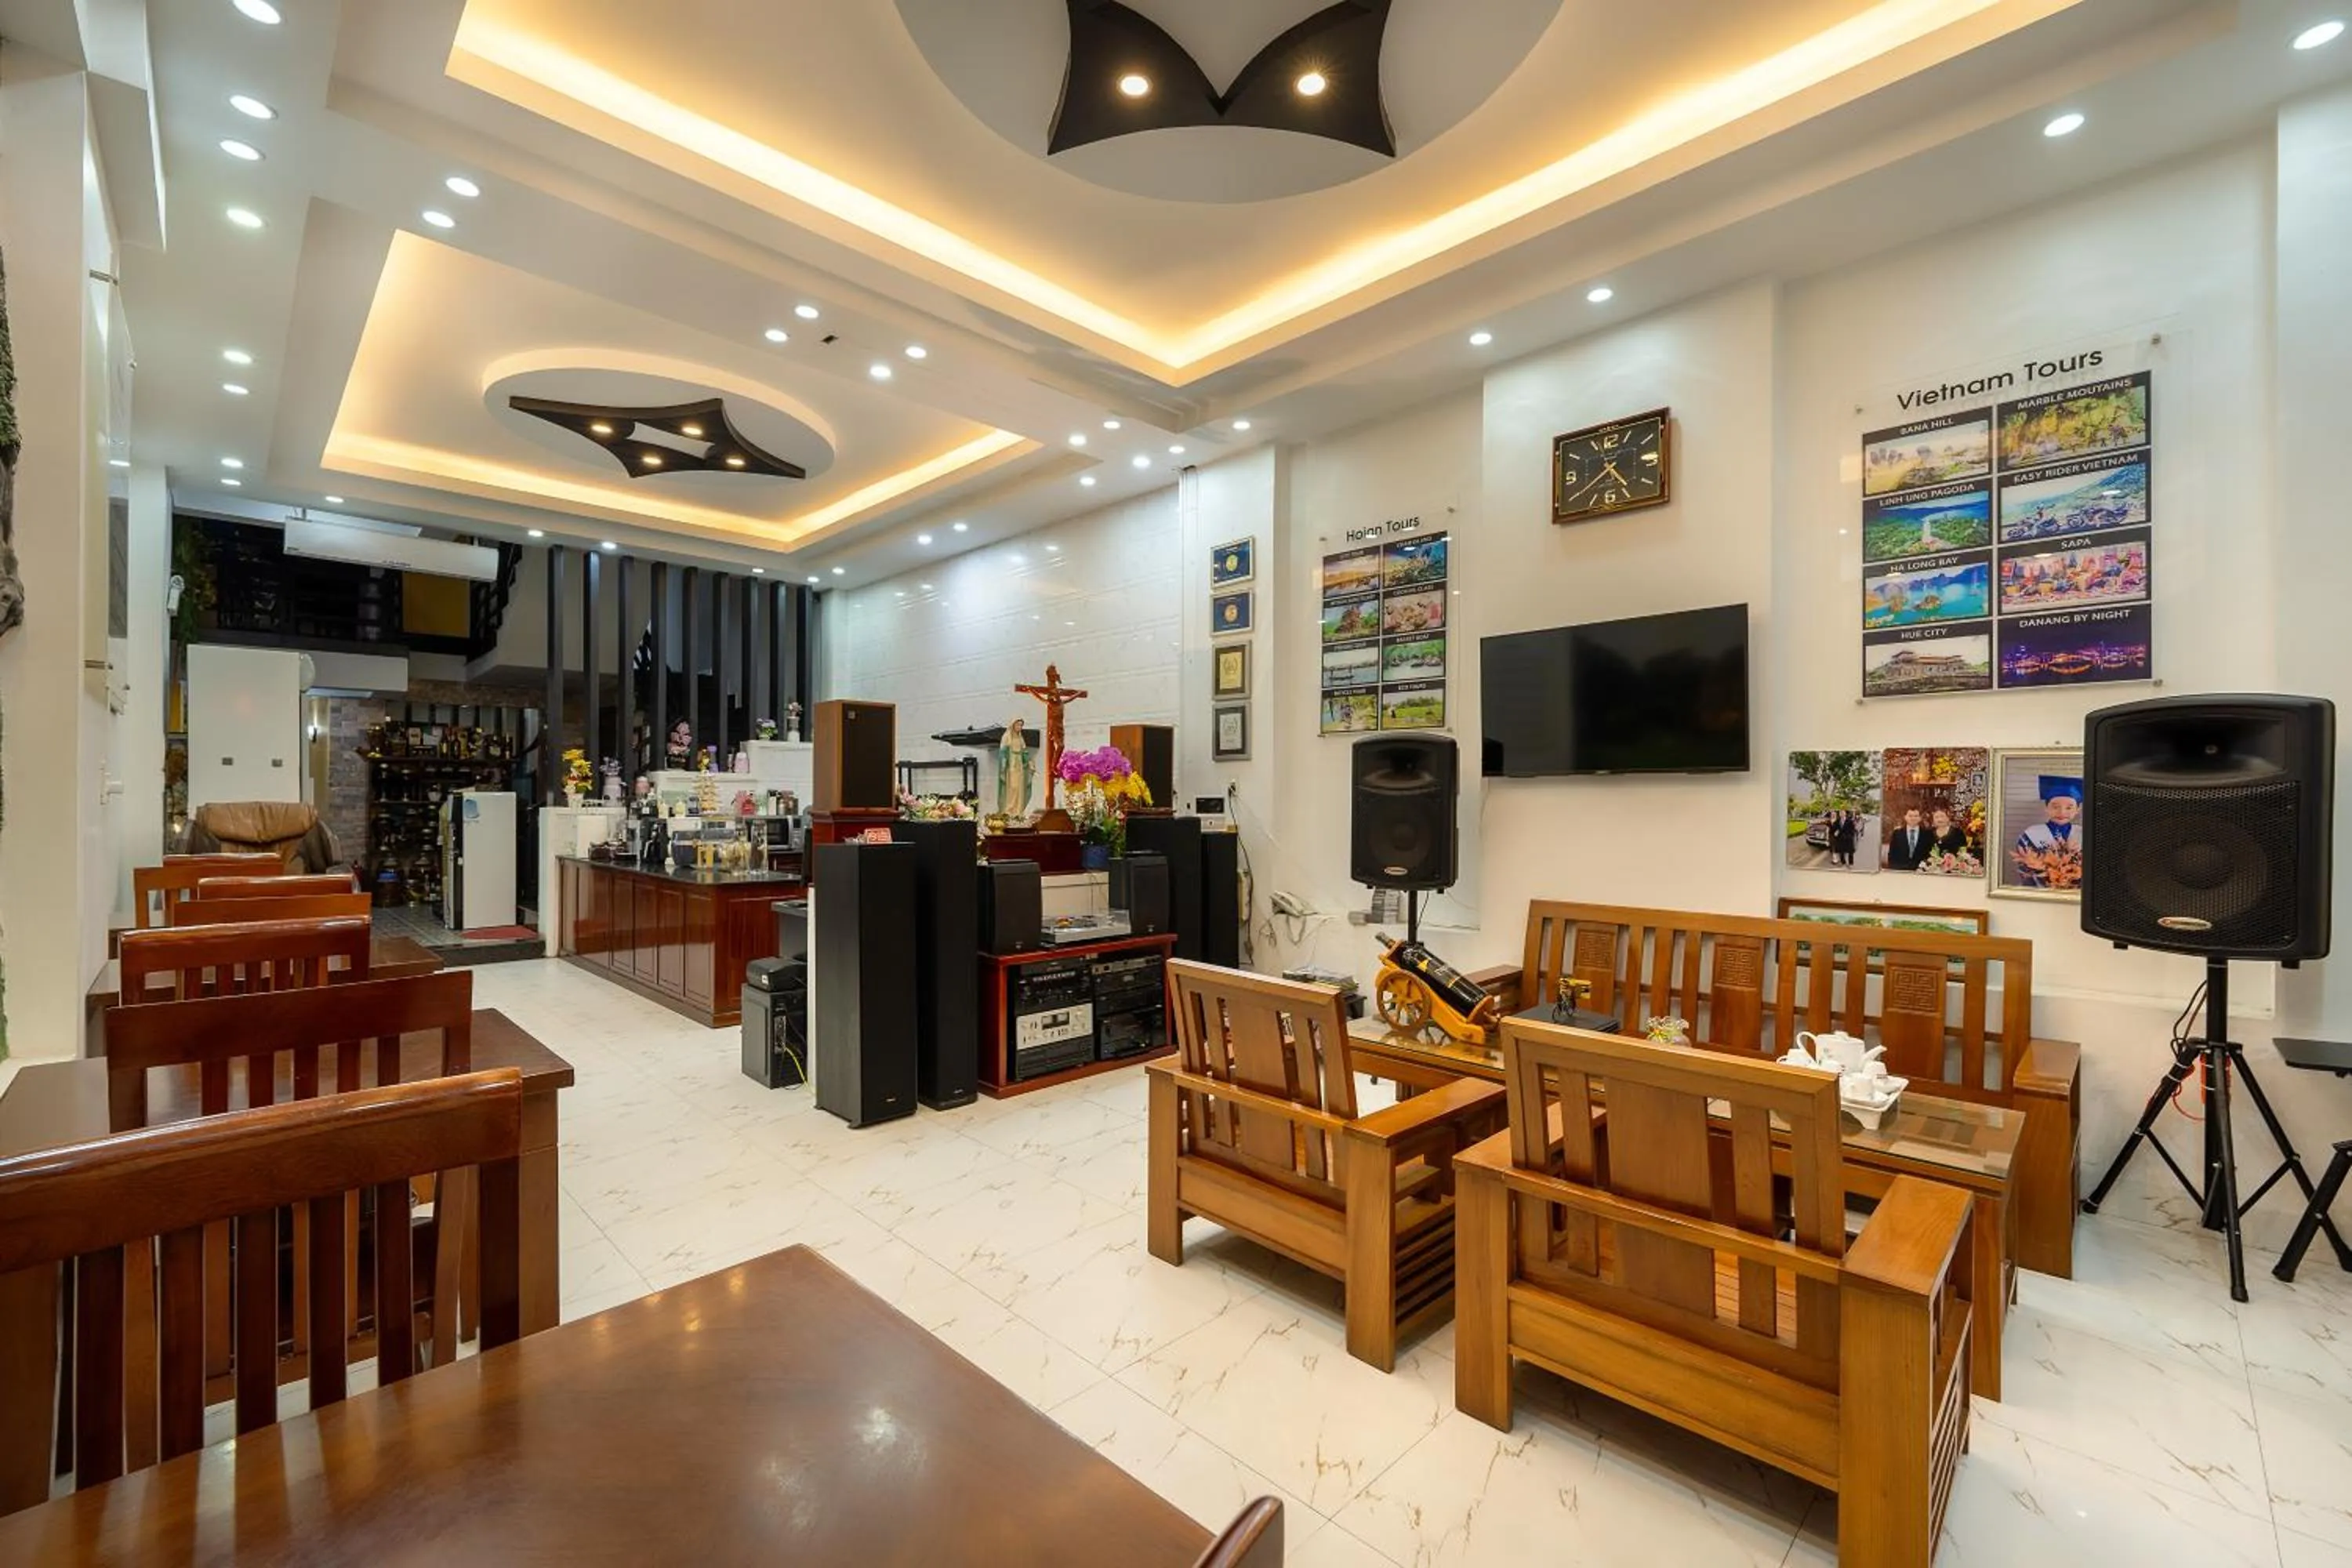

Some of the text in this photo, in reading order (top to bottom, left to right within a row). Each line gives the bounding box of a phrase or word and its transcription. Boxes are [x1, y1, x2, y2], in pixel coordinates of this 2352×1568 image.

[1896, 350, 2103, 410] Vietnam Tours
[2017, 391, 2063, 410] MARBLE
[1900, 417, 1954, 435] BANA HILL
[1604, 434, 1619, 448] 12
[2013, 453, 2139, 485] EASY RIDER VIETNAM
[1566, 471, 1577, 485] 9
[1605, 489, 1616, 503] 6
[1930, 482, 1975, 498] PAGODA
[1346, 524, 1382, 543] Hoian
[1386, 516, 1420, 533] Tours
[2060, 537, 2091, 550] SAPA
[1890, 556, 1958, 573] HA LONG BAY
[2019, 609, 2132, 629] DANANG BY NIGHT
[1923, 627, 1947, 638] CITY
